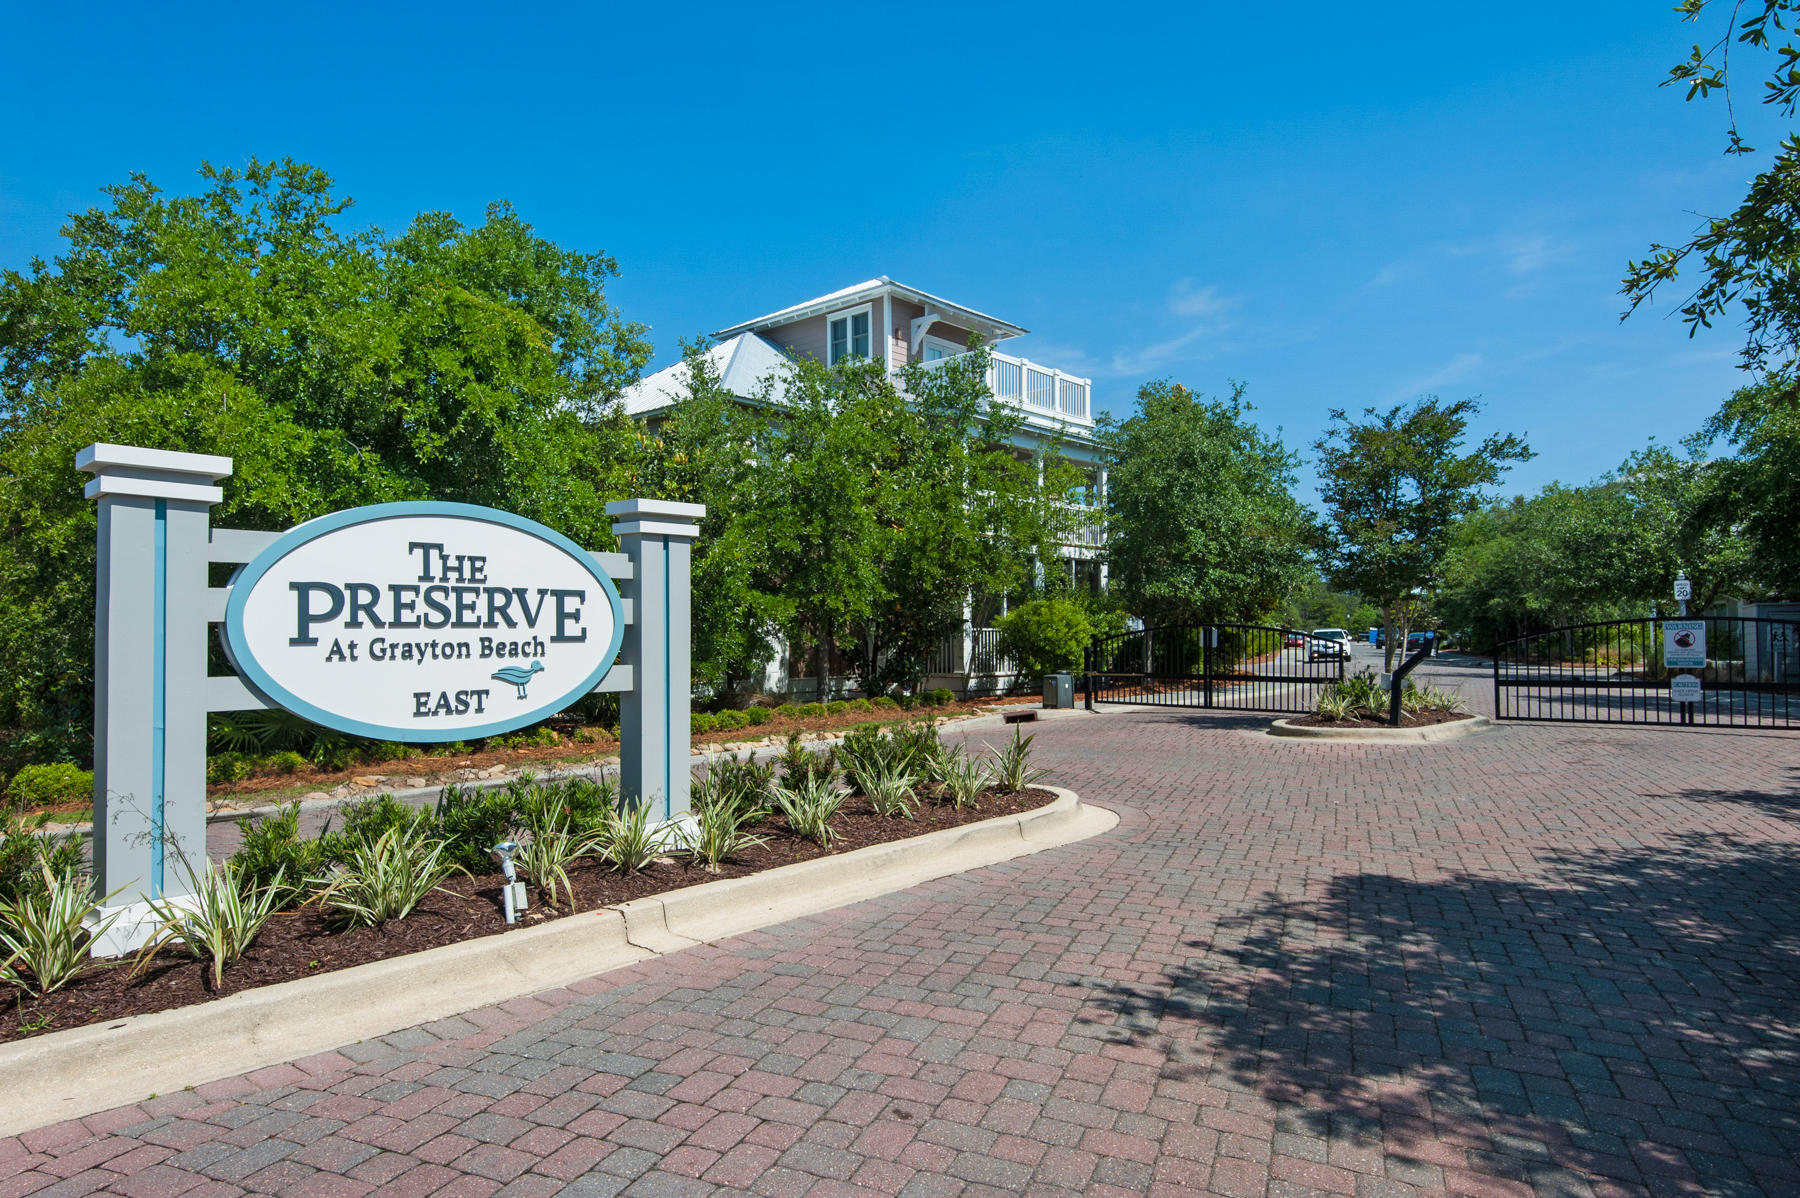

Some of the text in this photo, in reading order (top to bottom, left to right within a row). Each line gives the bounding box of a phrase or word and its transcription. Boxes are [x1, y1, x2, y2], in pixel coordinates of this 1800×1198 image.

[409, 541, 488, 584] THE
[1677, 589, 1688, 597] 20
[289, 581, 587, 645] PRESERVE
[325, 635, 546, 665] At Grayton Beach
[412, 689, 490, 718] EAST
